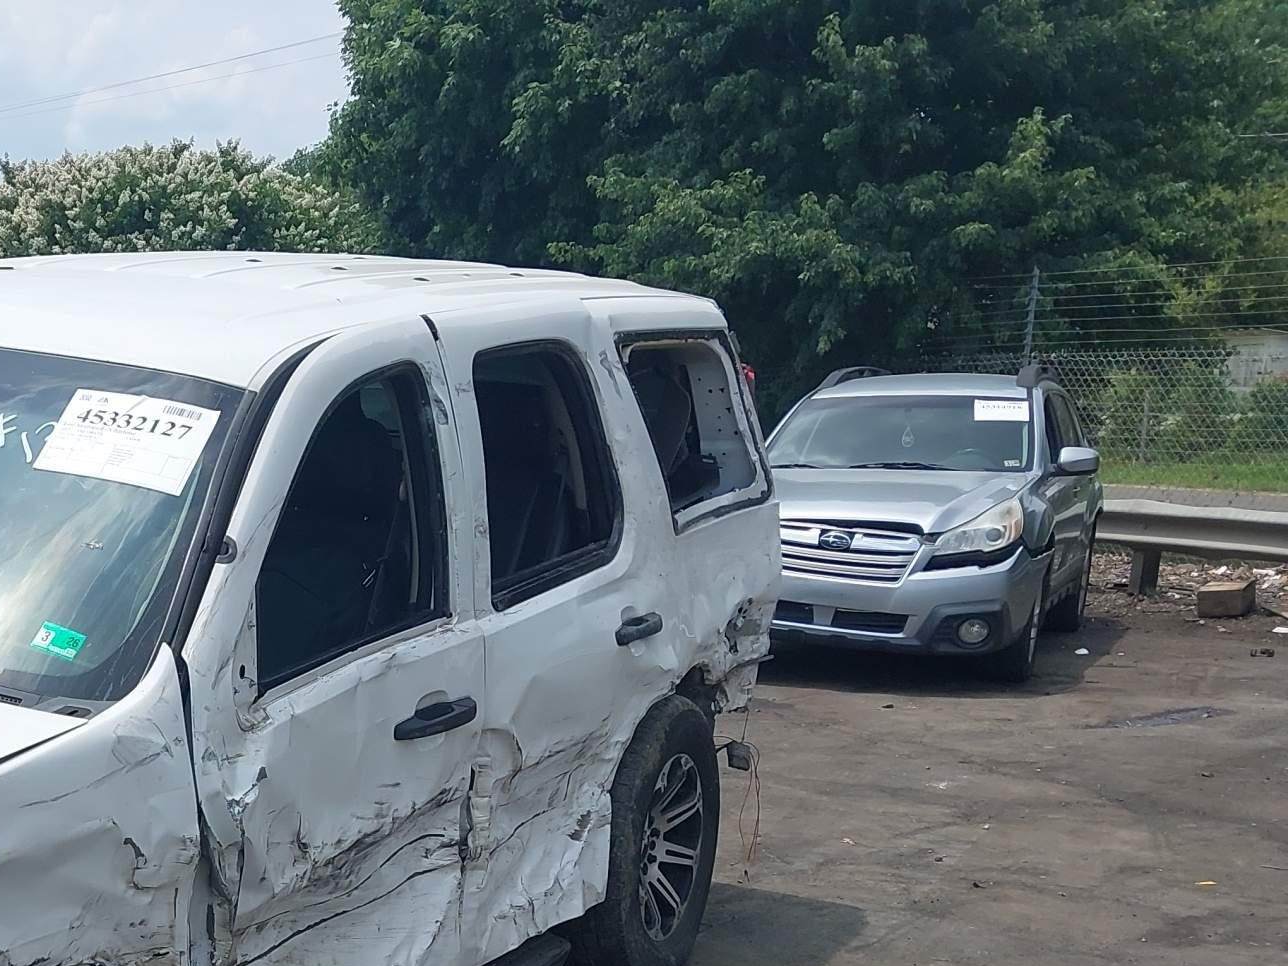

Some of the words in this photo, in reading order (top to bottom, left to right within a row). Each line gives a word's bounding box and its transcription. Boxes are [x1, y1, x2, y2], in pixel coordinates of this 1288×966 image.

[77, 409, 193, 440] 45332127
[42, 632, 51, 642] 3
[66, 637, 80, 648] 26
